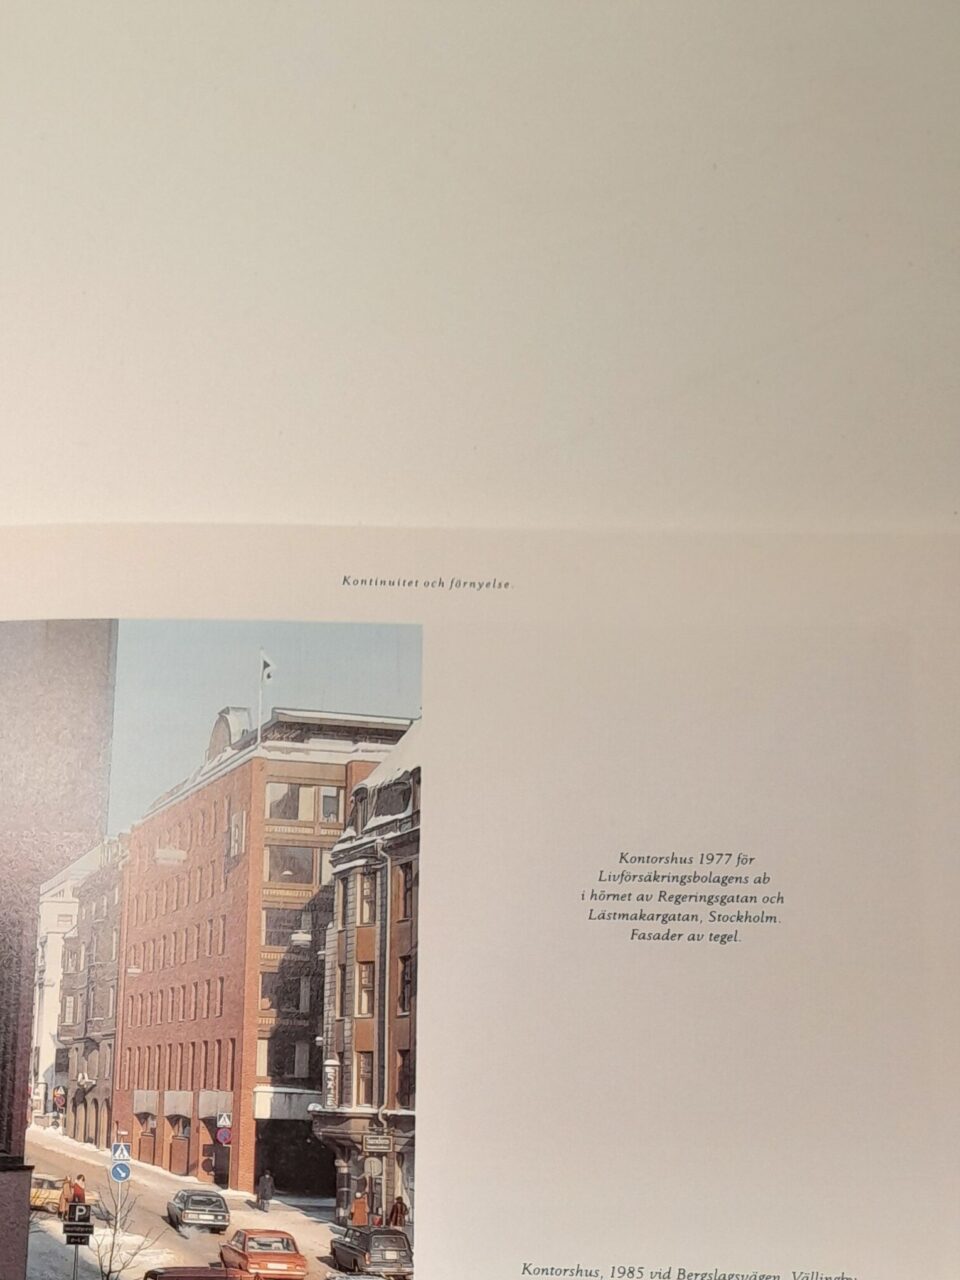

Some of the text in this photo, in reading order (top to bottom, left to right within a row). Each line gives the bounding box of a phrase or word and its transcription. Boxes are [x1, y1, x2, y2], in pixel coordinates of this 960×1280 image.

[341, 575, 419, 588] Kontinuitet
[423, 576, 445, 589] och
[618, 851, 756, 868] Kontorshus 1977 för
[598, 869, 771, 887] Livförsäkringsbolagens ab
[580, 889, 785, 906] i hörnet av Regeringsgatan och
[588, 908, 782, 925] Lästmakargatan, Stockholm.
[630, 928, 684, 942] Fasader
[687, 932, 705, 942] av
[74, 1205, 87, 1222] P
[521, 1262, 604, 1280] Kontorshus,
[610, 1265, 645, 1280] 1985
[650, 1266, 672, 1280] vid
